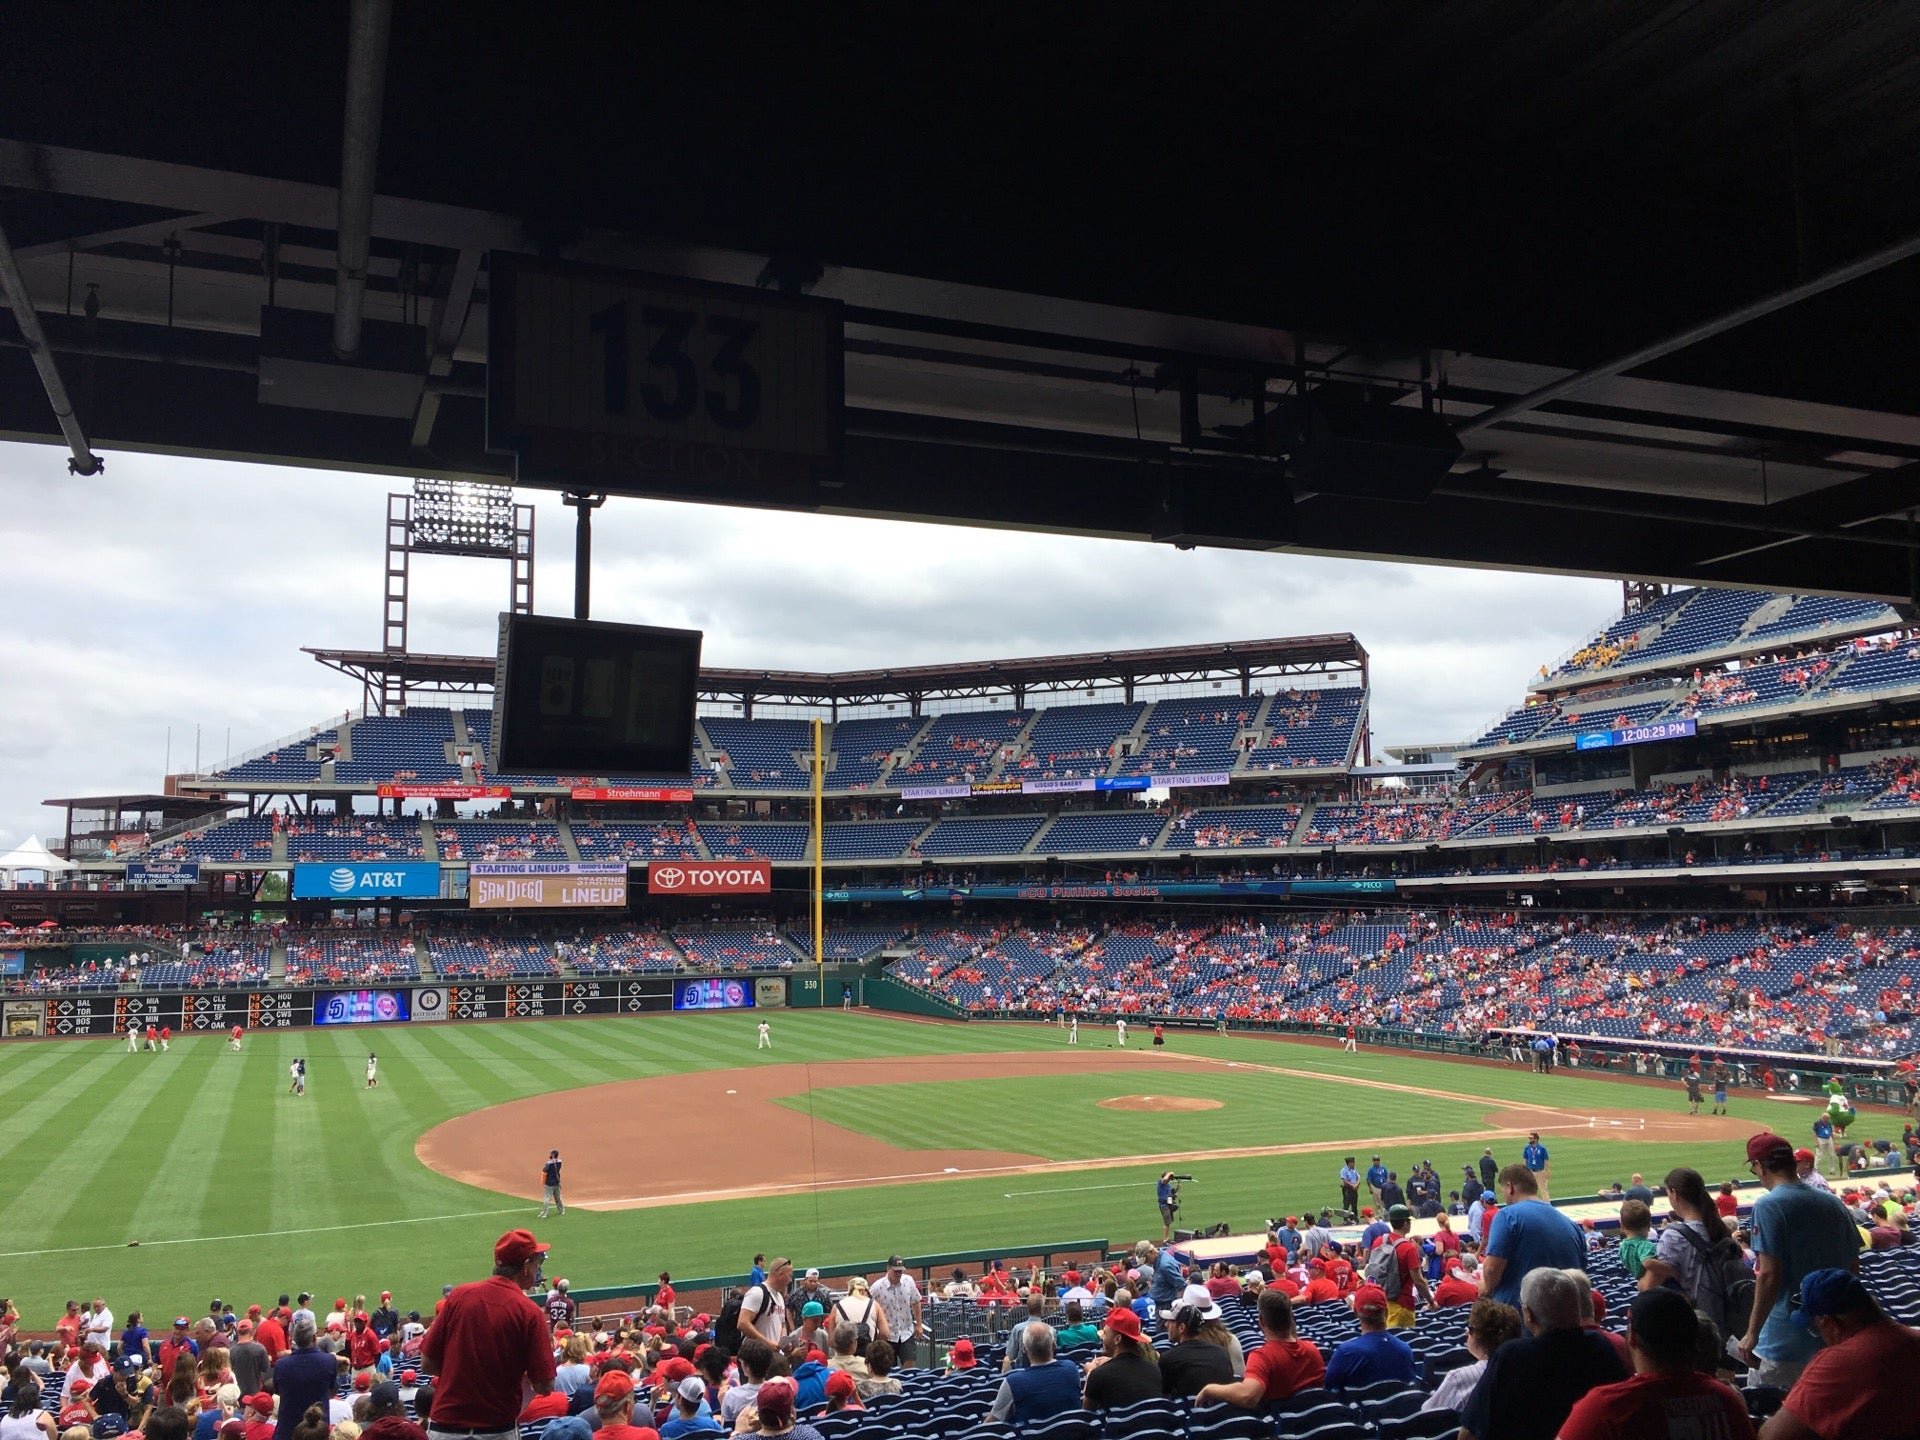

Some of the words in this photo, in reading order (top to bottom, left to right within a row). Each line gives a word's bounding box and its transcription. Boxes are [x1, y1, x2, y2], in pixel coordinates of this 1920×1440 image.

[590, 299, 761, 431] 133
[590, 437, 760, 480] SECTION
[1621, 726, 1665, 742] 12:00:29
[1669, 723, 1686, 735] PM
[1152, 776, 1191, 786] STARTING
[1193, 774, 1227, 784] LINEUPS
[607, 789, 660, 798] Stroehmann
[903, 788, 937, 797] STARTING
[938, 787, 969, 796] LINEUPS
[475, 865, 525, 873] STARTING
[529, 864, 570, 873] LINEUPS
[360, 872, 406, 888] AT&T
[576, 877, 624, 886] STARTING
[688, 870, 765, 885] TOYOTA
[479, 881, 504, 904] SAN
[507, 880, 543, 902] DIEGO
[562, 888, 624, 903] LINEUP
[1052, 887, 1108, 897] Phillies
[1113, 885, 1159, 896] Socks
[531, 984, 544, 992] LAD
[804, 980, 817, 990] 330
[77, 1008, 91, 1016] TOR
[413, 1010, 446, 1018] ROTHMAN
[531, 1008, 544, 1016] CHC
[277, 1019, 290, 1027] SEA
[550, 1309, 567, 1320] 32
